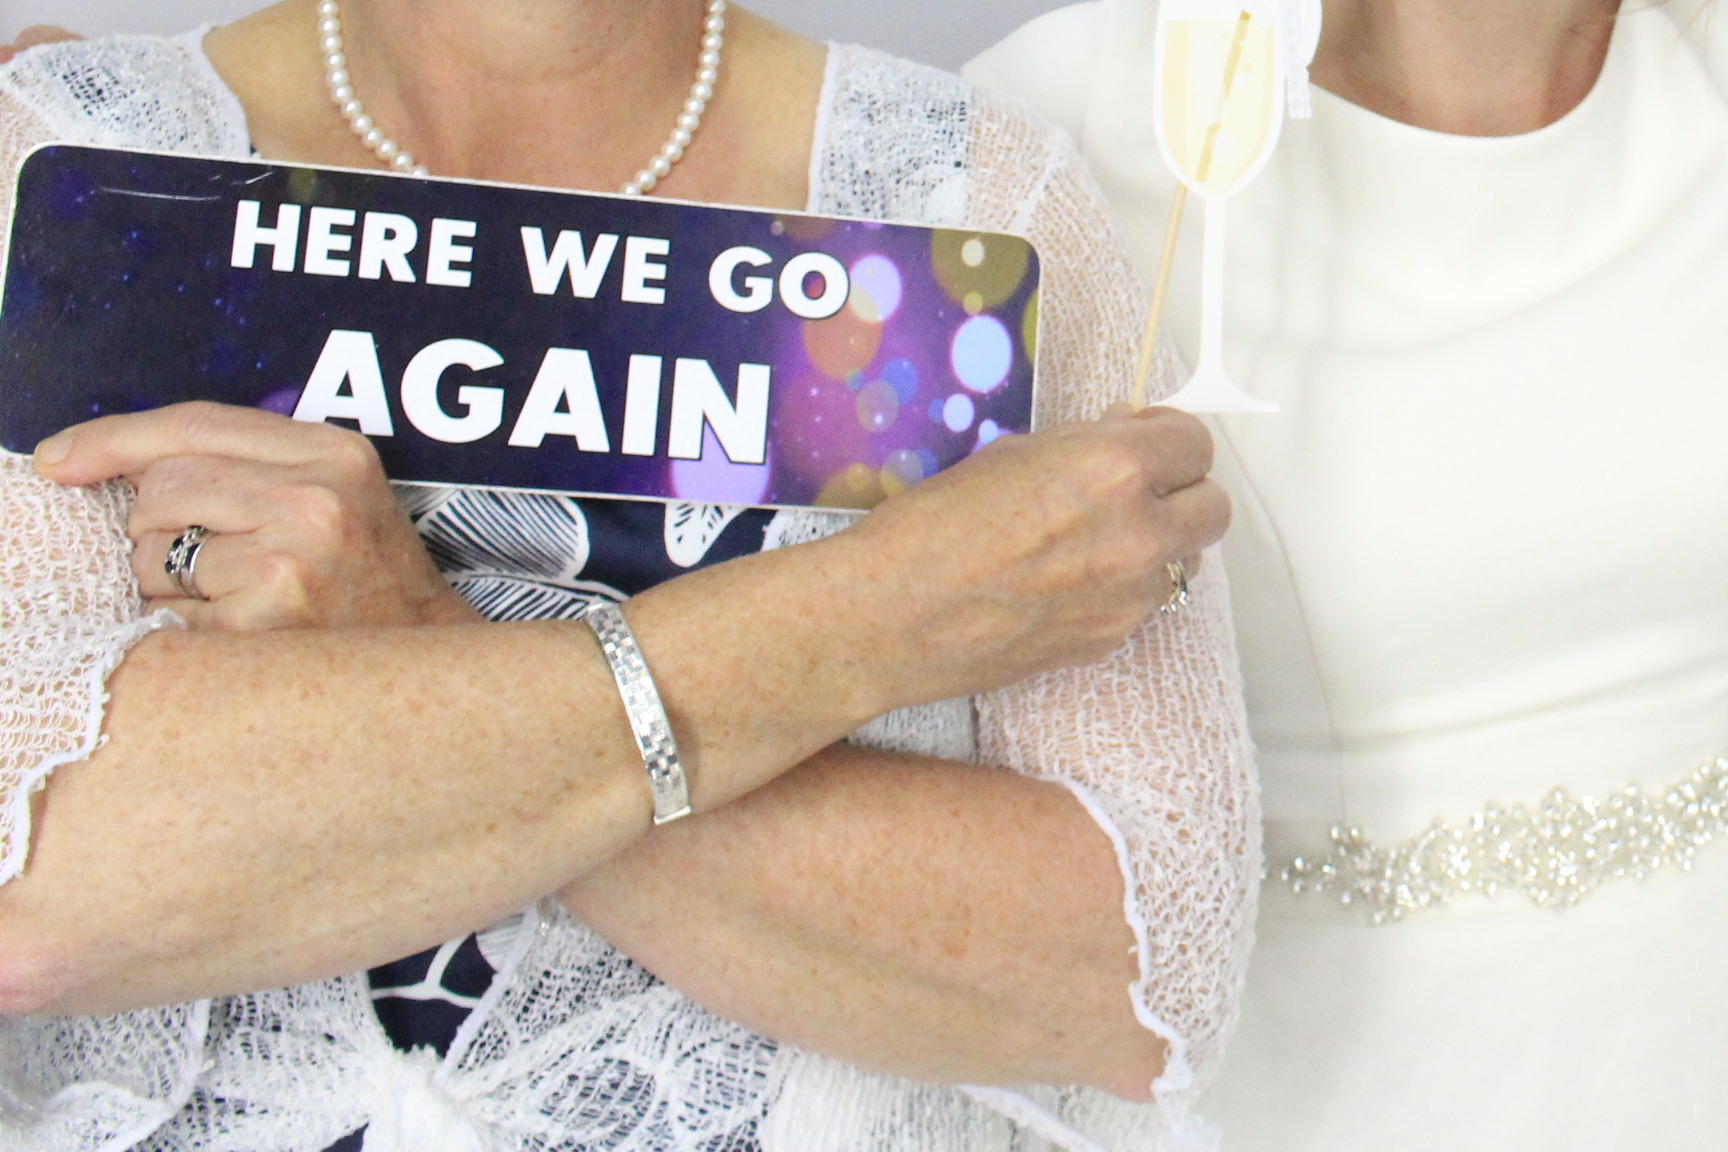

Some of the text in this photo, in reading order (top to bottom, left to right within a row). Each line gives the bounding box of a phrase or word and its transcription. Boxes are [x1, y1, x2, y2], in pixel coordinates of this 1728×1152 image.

[230, 199, 851, 320] HERE WE GO
[292, 329, 773, 465] AGAIN
